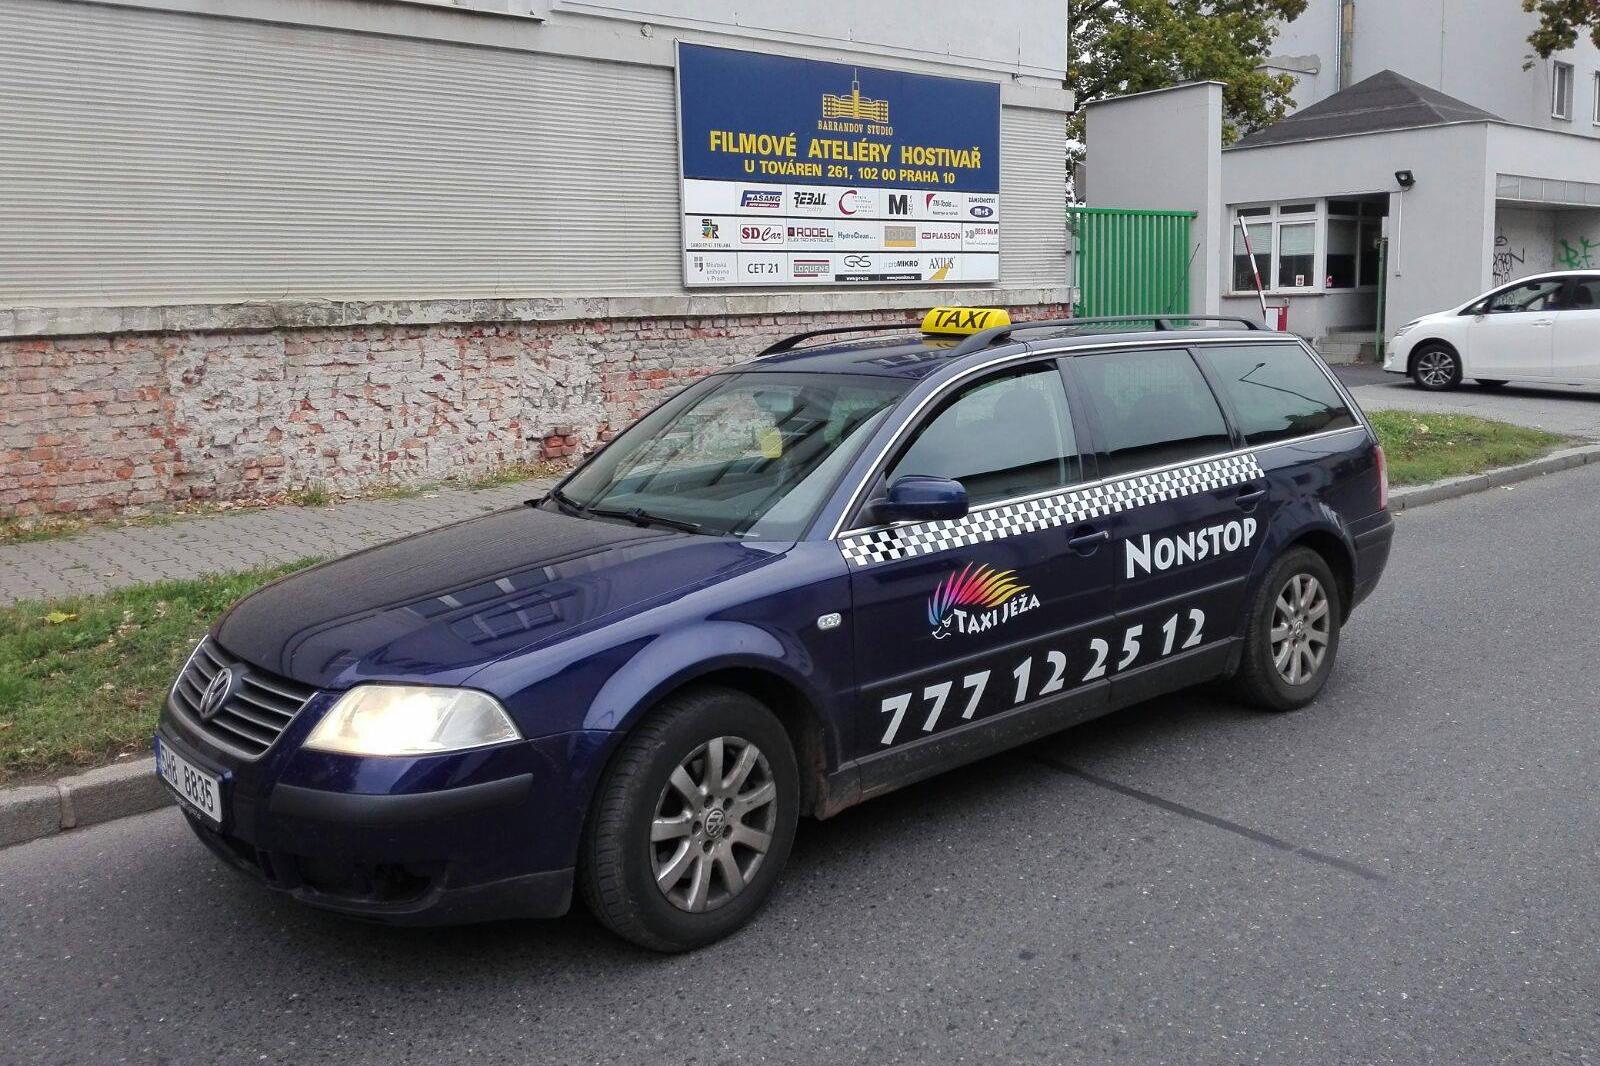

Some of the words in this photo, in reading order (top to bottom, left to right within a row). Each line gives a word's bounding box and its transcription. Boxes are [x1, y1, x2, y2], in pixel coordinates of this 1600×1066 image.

[818, 120, 863, 133] BARRANDOV
[867, 124, 894, 136] STUDIO
[709, 130, 797, 157] FILMOVÉ
[808, 137, 891, 163] ATELIÉRY
[901, 145, 981, 169] HOSTIVAŘ
[744, 159, 755, 173] U
[760, 159, 822, 177] TOVÁREN
[827, 164, 853, 180] 261,
[858, 167, 879, 180] 102
[881, 168, 896, 181] 00
[900, 169, 939, 183] PRAHA
[942, 172, 955, 184] 10
[741, 227, 760, 240] SD
[761, 226, 782, 242] Car
[932, 232, 961, 240] PLASSON
[747, 263, 766, 274] CET
[768, 263, 779, 274] 21
[934, 309, 992, 329] TAXI
[1125, 517, 1258, 580] NONSTOP
[953, 608, 999, 635] TAXI
[1001, 592, 1041, 624] JÉŽA
[880, 669, 991, 745] 777
[1013, 650, 1067, 704] 12
[1081, 623, 1144, 682] 25
[1161, 608, 1206, 656] 12
[184, 765, 214, 813] 8835
